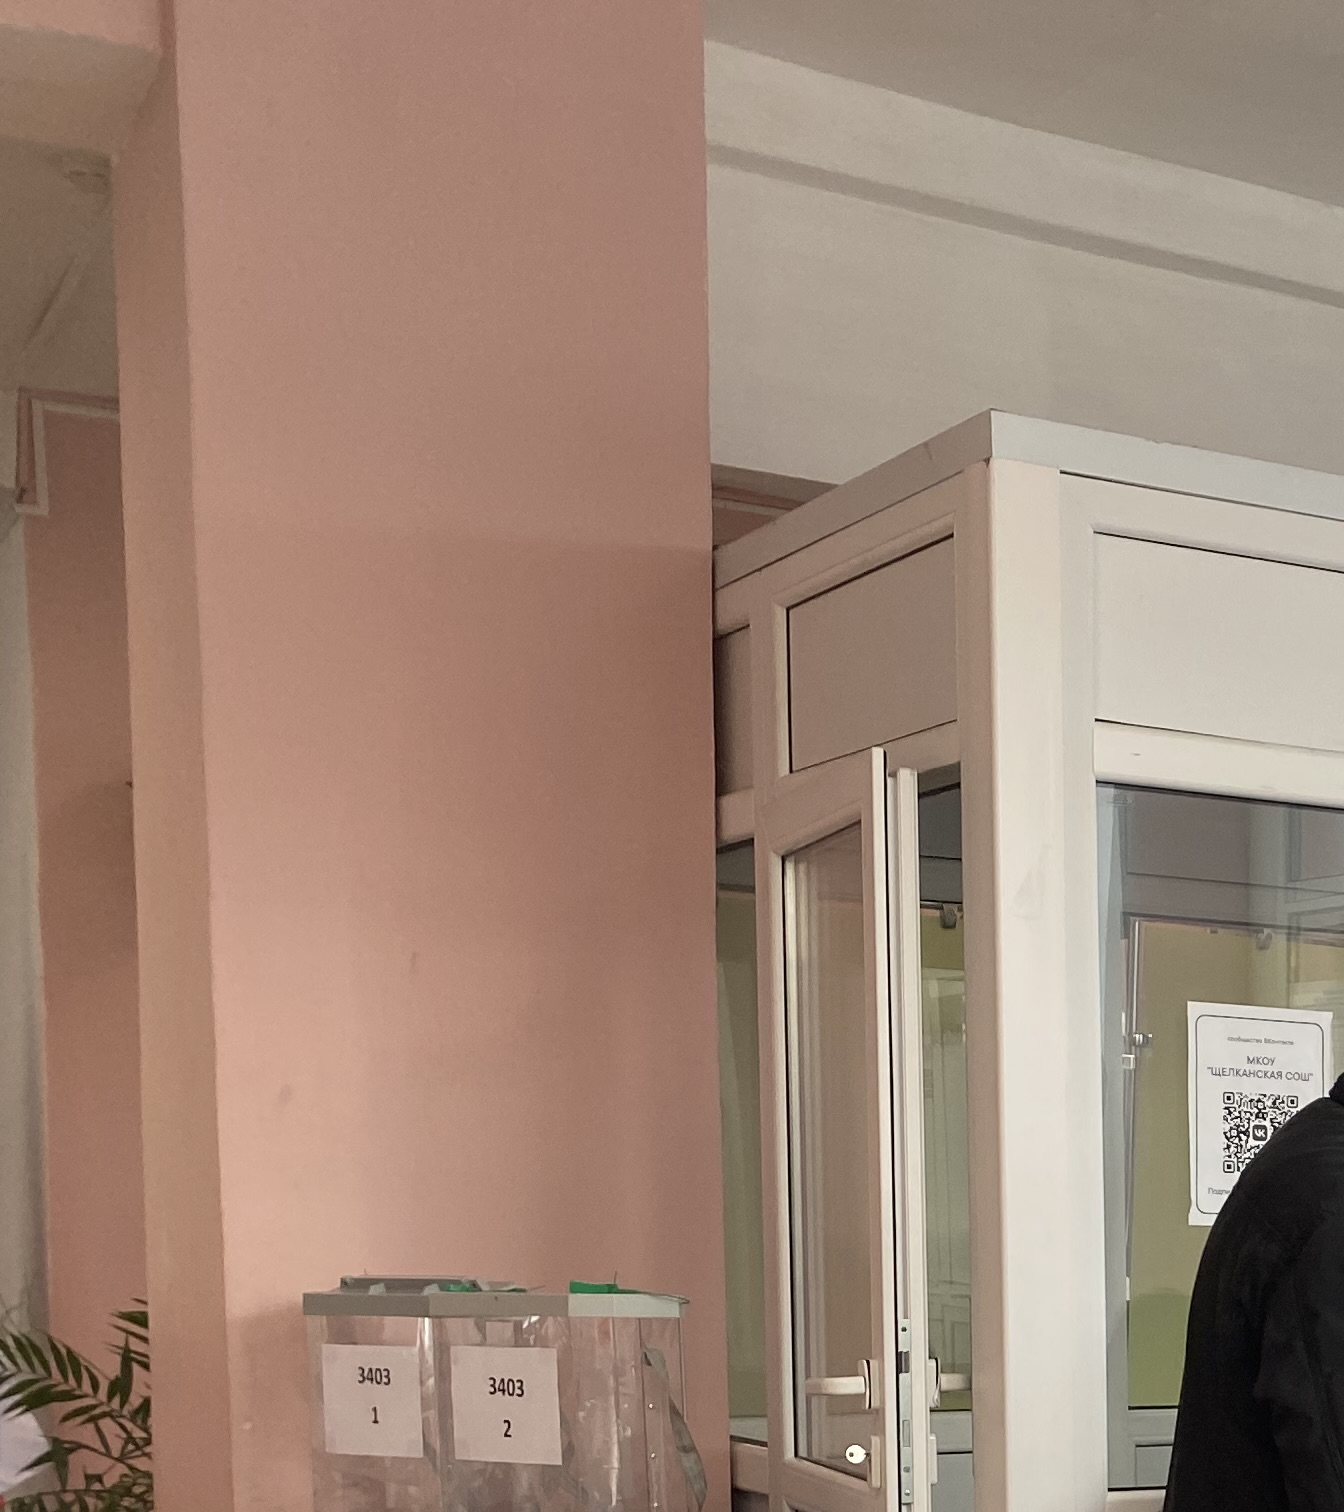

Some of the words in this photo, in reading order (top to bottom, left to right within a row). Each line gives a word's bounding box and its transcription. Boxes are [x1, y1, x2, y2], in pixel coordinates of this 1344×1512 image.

[1246, 1055, 1276, 1066] МКОУ
[1207, 1066, 1283, 1081] "ЩЕЛКАНСКАЯ
[1285, 1071, 1314, 1082] СОШ"
[357, 1366, 391, 1386] 3403
[488, 1376, 525, 1398] 3403
[371, 1406, 379, 1424] 1
[502, 1419, 512, 1438] 2
